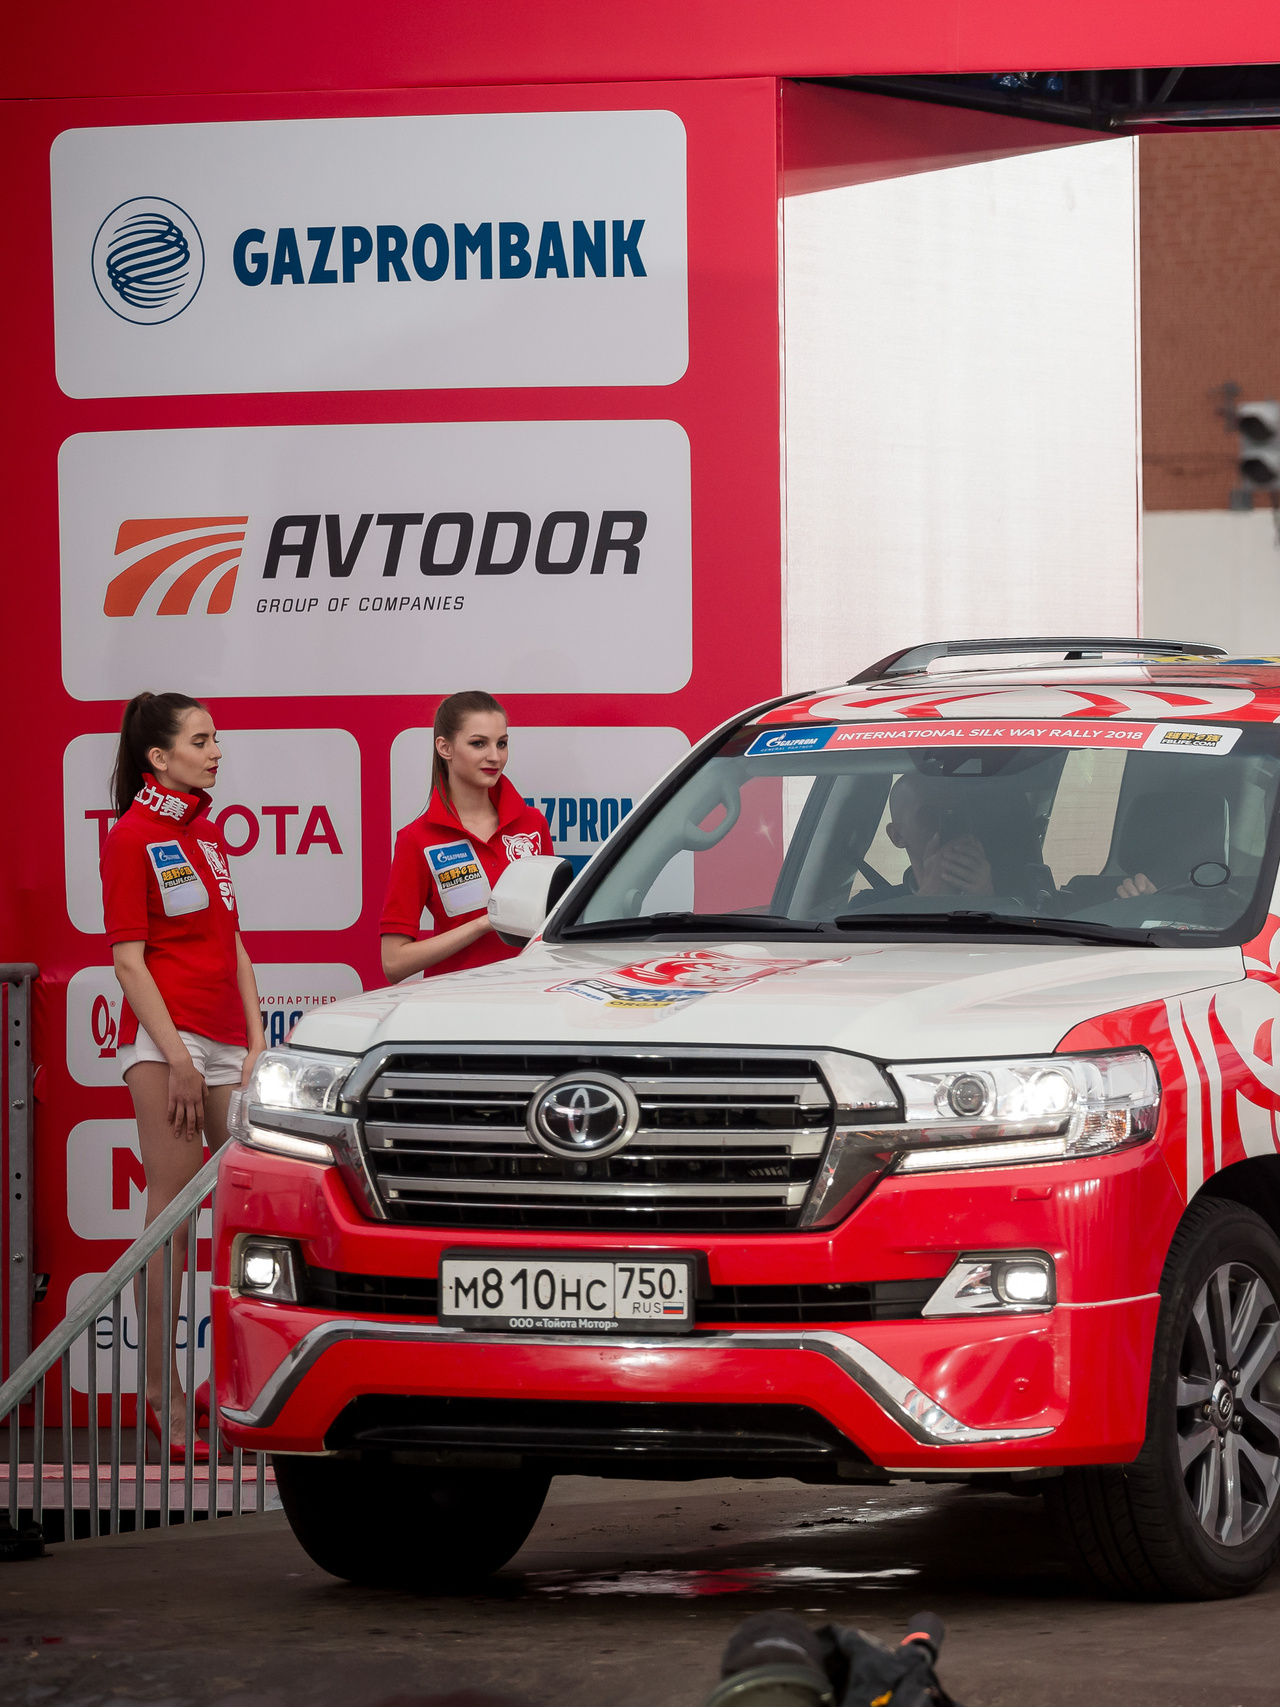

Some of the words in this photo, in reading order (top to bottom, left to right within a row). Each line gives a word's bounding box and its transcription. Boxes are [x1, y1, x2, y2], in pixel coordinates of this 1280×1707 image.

[233, 219, 648, 286] GAZPROMBANK
[262, 510, 648, 579] AVTODOR
[256, 598, 319, 613] GROUP
[327, 597, 350, 612] OF
[358, 596, 465, 611] COMPANIES
[836, 729, 964, 741] INTERNATIONAL
[968, 728, 1005, 737] SILK
[1008, 728, 1048, 737] WAY
[1049, 728, 1104, 738] RALLY
[1104, 730, 1144, 740] 2018
[1161, 739, 1216, 747] FBLIFE.COM
[618, 1267, 676, 1299] 750
[632, 1302, 662, 1314] RUS
[509, 1318, 534, 1328] ООО
[535, 1318, 578, 1329] «Тойота
[578, 1318, 618, 1330] Мотор»
